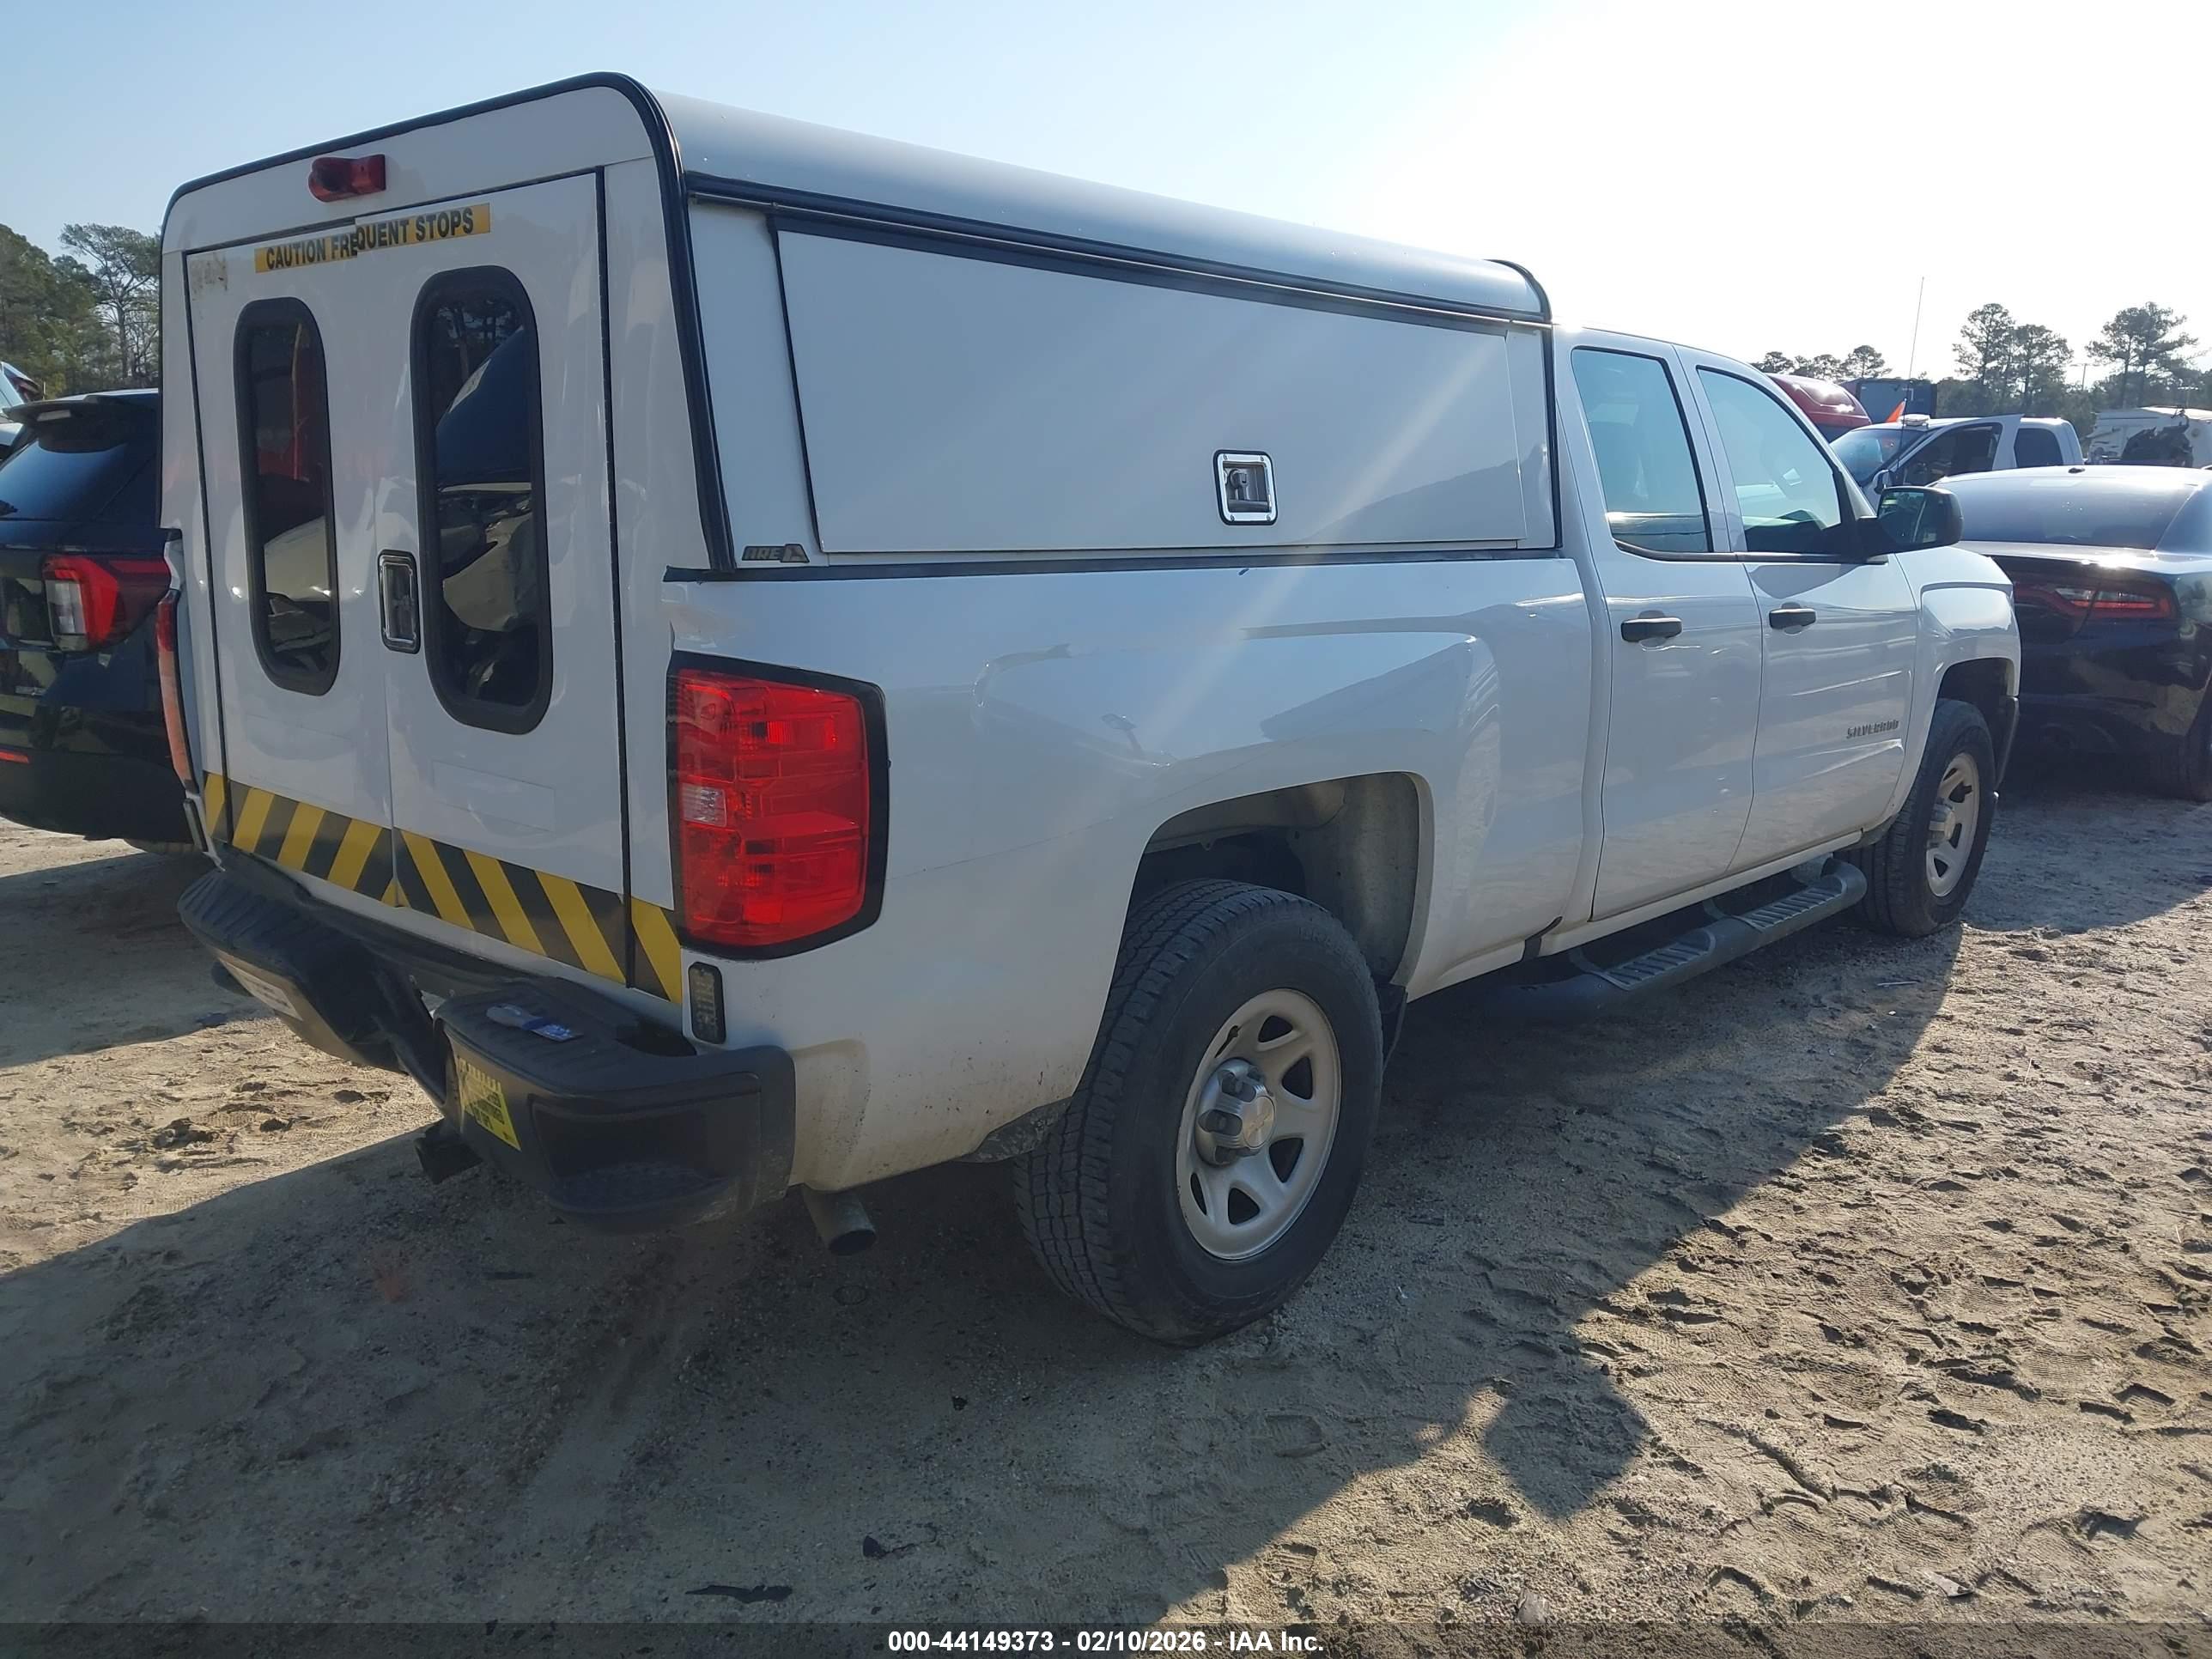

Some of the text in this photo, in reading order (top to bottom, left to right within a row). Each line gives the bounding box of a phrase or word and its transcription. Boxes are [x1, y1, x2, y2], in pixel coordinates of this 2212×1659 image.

[266, 207, 474, 270] CAUTION FREQUENT STOPS
[1846, 720, 1899, 738] SILVERADO
